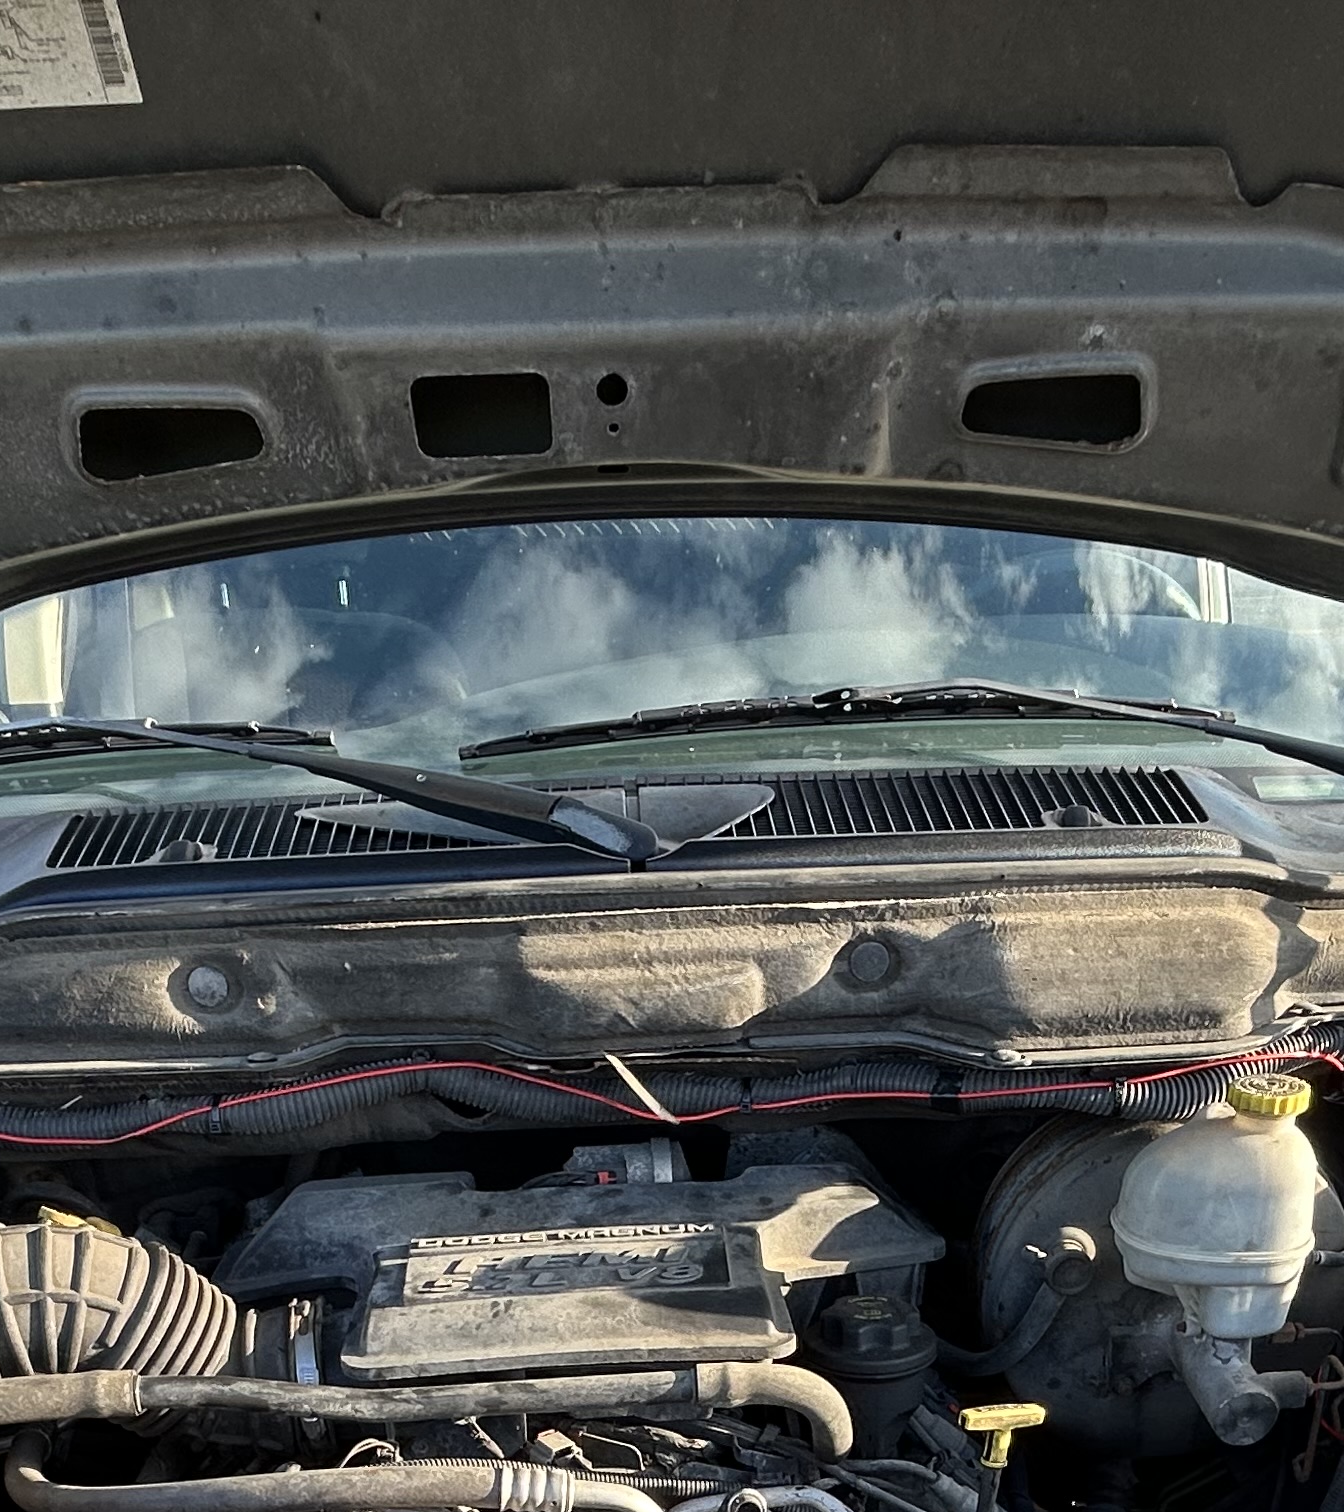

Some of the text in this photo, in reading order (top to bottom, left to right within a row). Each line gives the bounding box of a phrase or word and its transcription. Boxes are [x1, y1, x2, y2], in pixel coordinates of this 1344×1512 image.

[417, 1223, 715, 1249] DODGE MAGNUM
[443, 1247, 689, 1276] HEMI
[616, 1263, 703, 1285] V8
